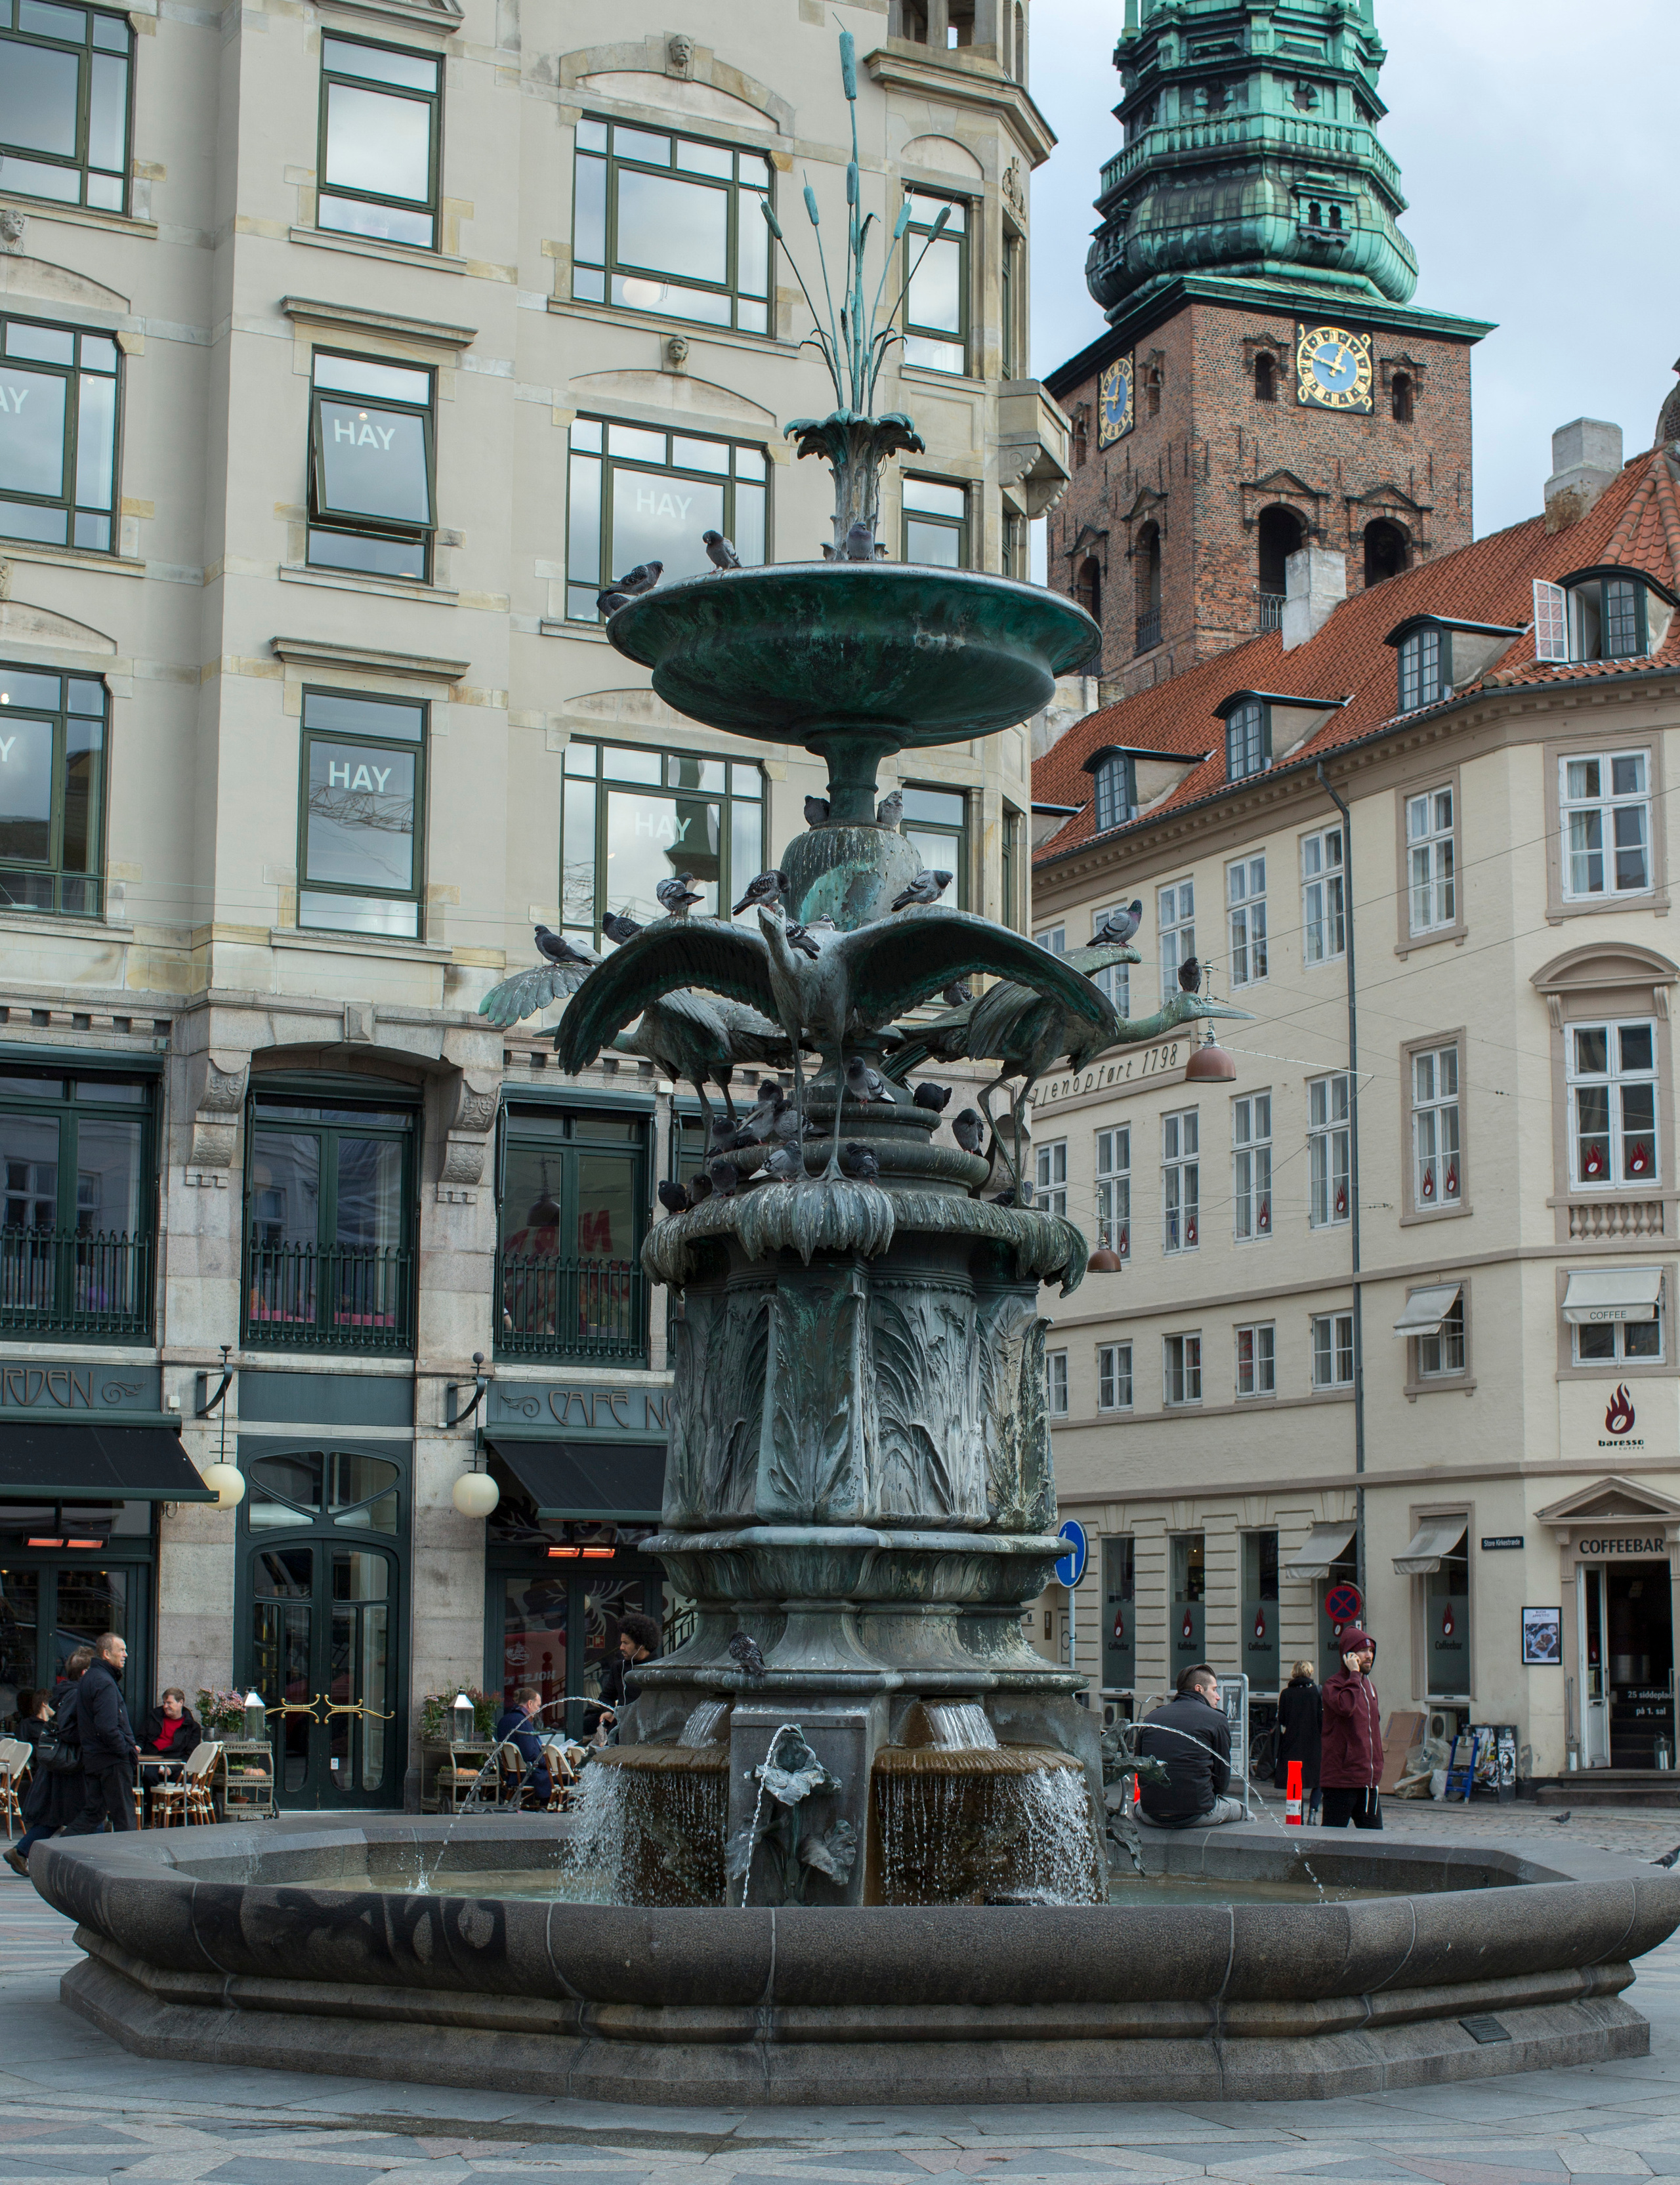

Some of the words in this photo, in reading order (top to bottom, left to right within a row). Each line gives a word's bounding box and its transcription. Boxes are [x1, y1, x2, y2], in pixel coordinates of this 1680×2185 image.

[333, 419, 396, 450] HAY
[636, 488, 693, 520] HAY
[329, 760, 392, 793] HAY
[634, 811, 692, 842] HAY
[1142, 1043, 1178, 1074] 1798
[1589, 1310, 1627, 1320] COFFEE
[0, 1367, 94, 1409] RDEN
[1579, 1537, 1665, 1554] COFFEEBAR
[1248, 1641, 1272, 1652] Coffeebar
[1435, 1640, 1463, 1650] Coffeebar
[1635, 1707, 1645, 1717] på
